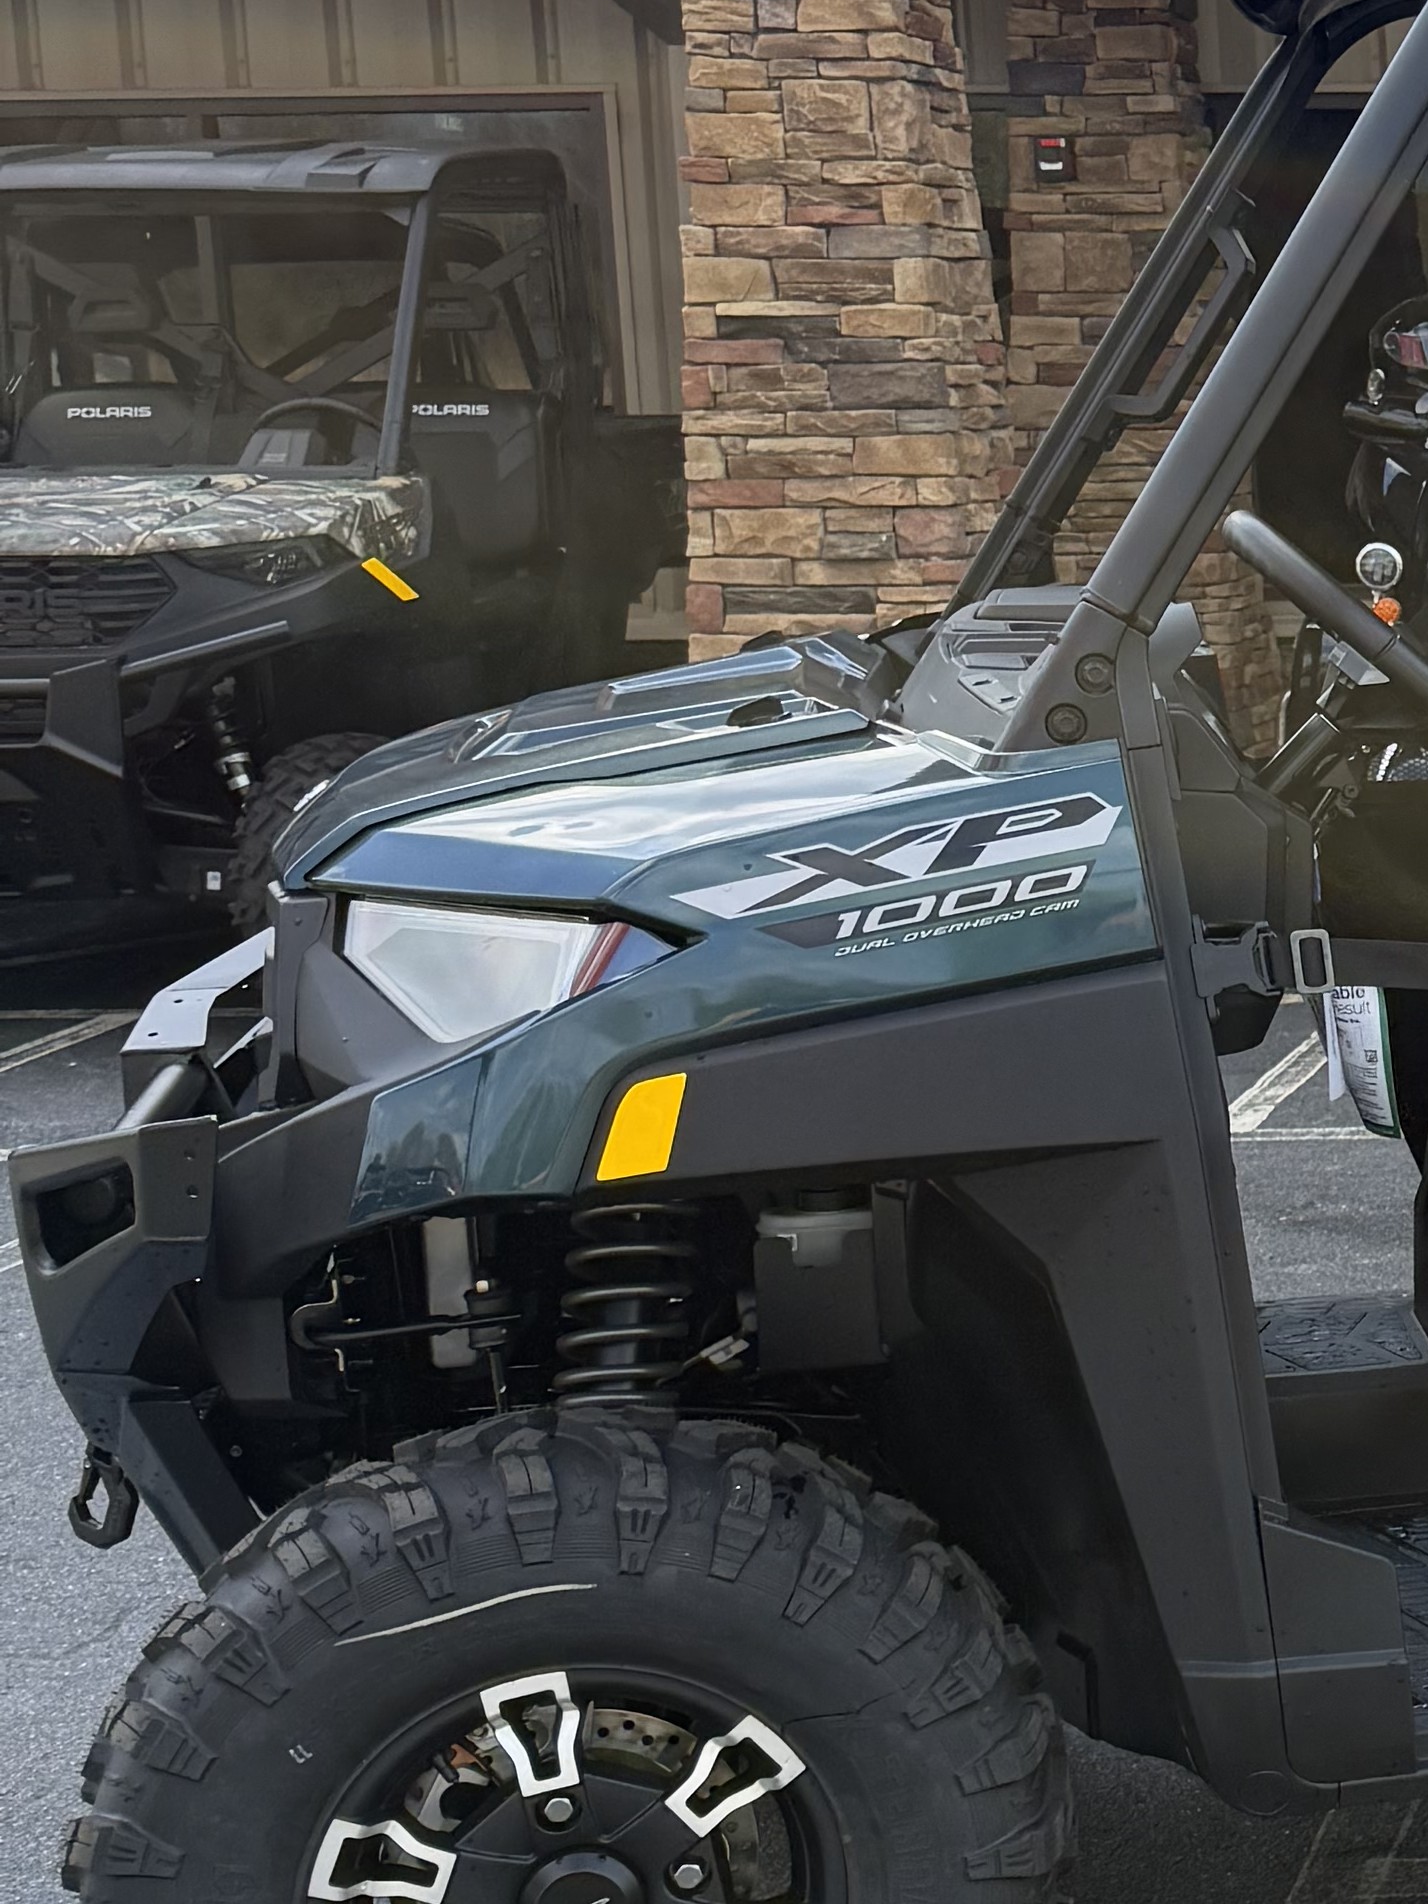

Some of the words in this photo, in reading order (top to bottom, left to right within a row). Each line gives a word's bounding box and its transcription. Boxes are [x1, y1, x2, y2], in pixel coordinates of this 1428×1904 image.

[67, 406, 152, 419] POLARIS
[736, 793, 1112, 916] XP
[834, 938, 896, 958] DUAL
[902, 908, 1026, 944] OVERHEAD
[1029, 898, 1080, 918] CAM
[835, 864, 1088, 940] 1000
